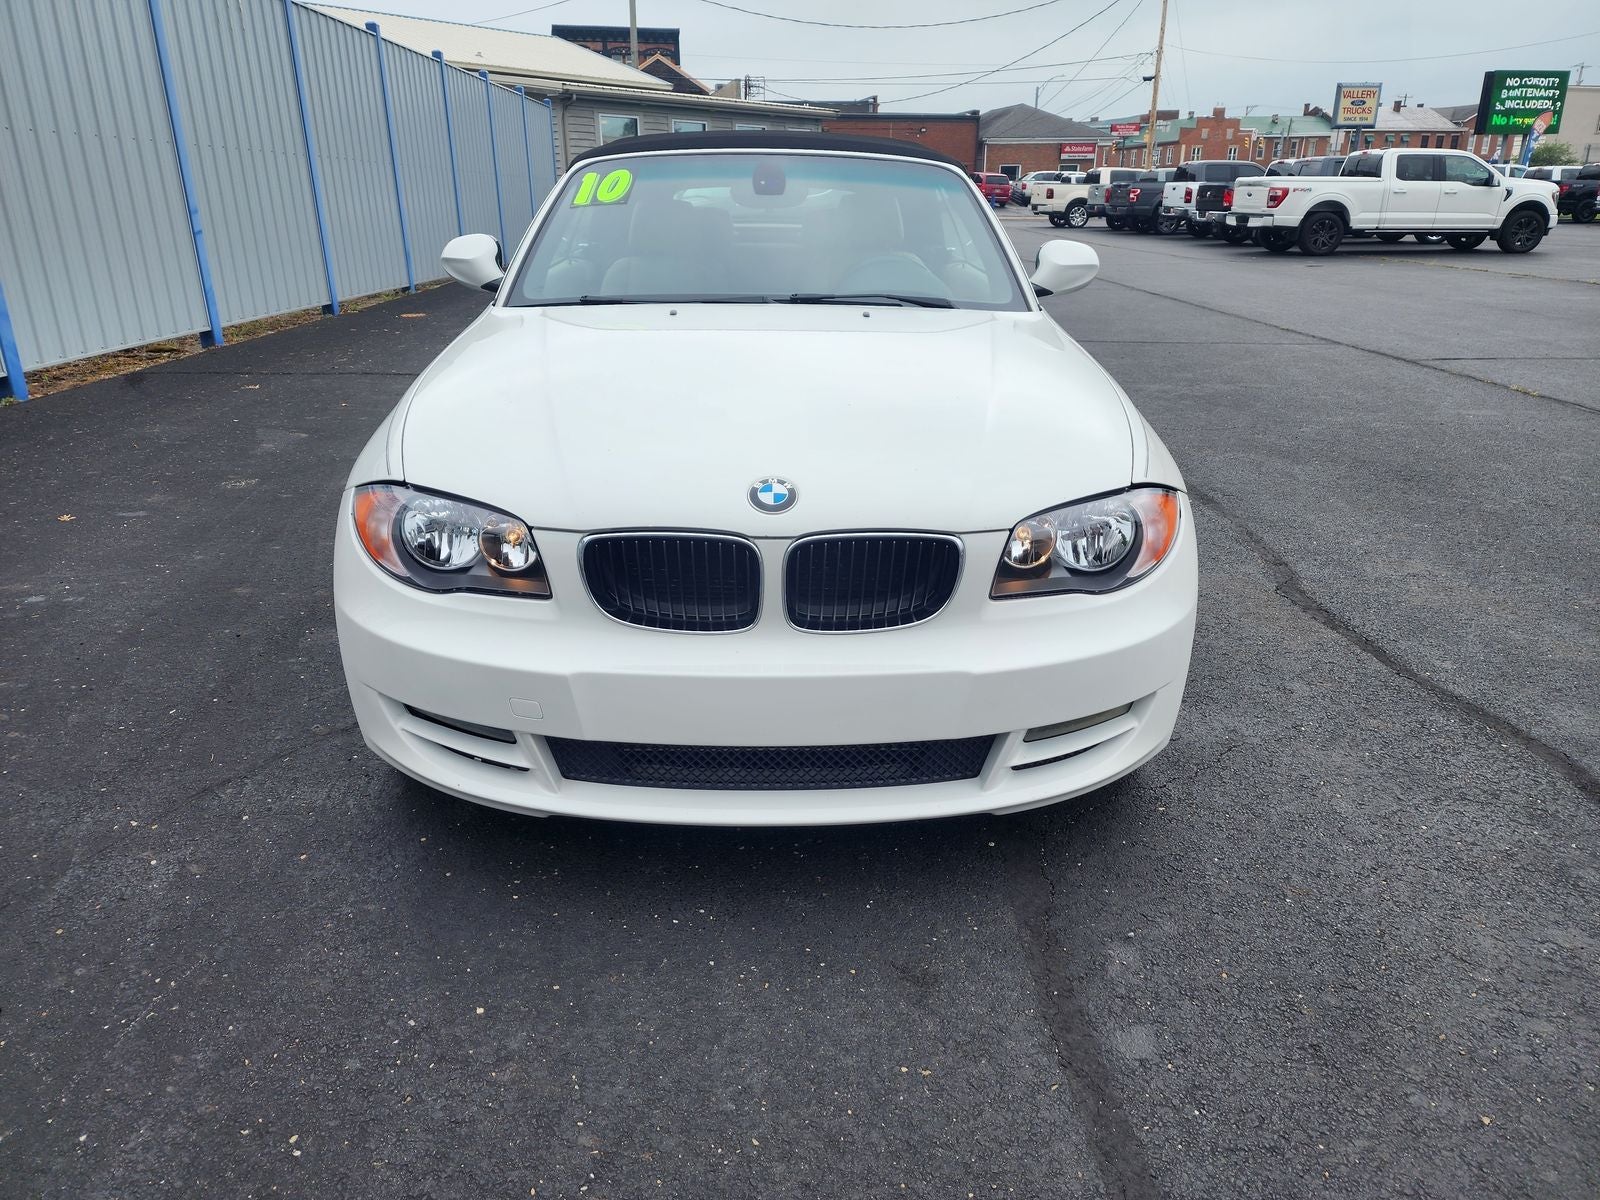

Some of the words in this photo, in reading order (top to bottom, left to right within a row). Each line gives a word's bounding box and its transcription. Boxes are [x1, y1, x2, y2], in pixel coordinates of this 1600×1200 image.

[1506, 77, 1520, 87] NO
[1343, 90, 1377, 99] VALLERY
[1343, 107, 1372, 115] TRUCKS
[573, 169, 632, 206] 10
